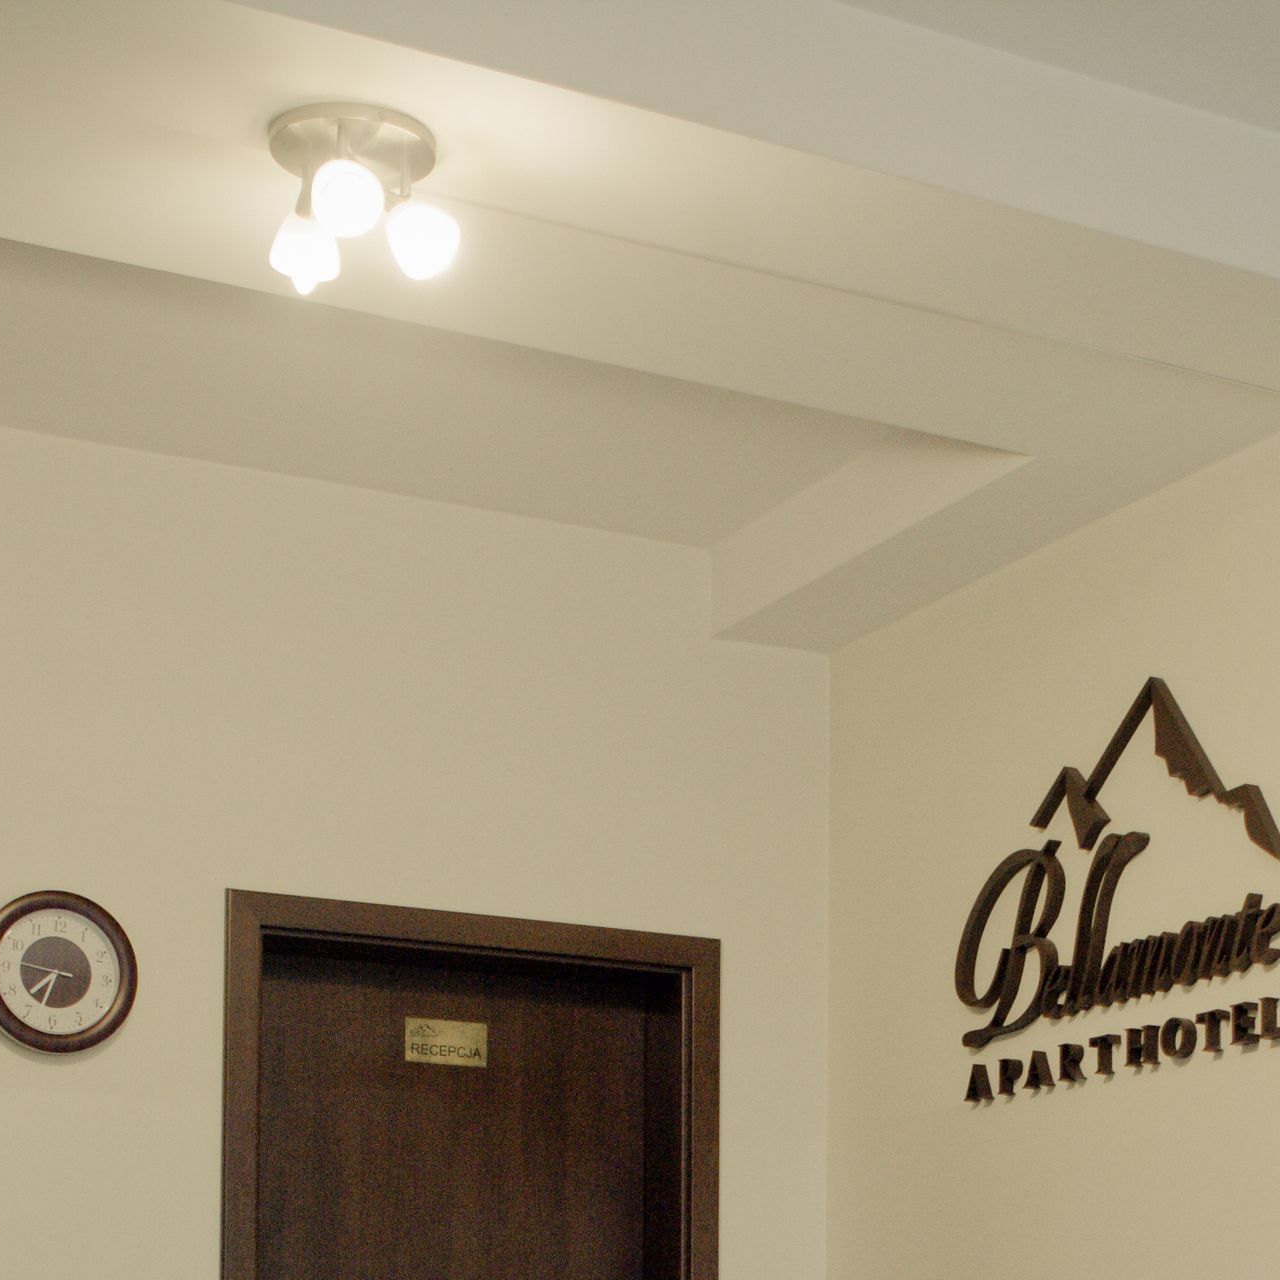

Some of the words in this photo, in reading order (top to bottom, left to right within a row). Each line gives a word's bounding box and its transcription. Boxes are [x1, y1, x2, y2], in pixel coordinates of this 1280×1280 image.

[31, 923, 41, 936] 11
[54, 919, 67, 933] 12
[13, 938, 24, 952] 10
[2, 960, 11, 972] 9
[8, 984, 17, 996] 8
[24, 1004, 32, 1017] 7
[48, 1014, 57, 1027] 6
[410, 1043, 482, 1059] RECEPCJA
